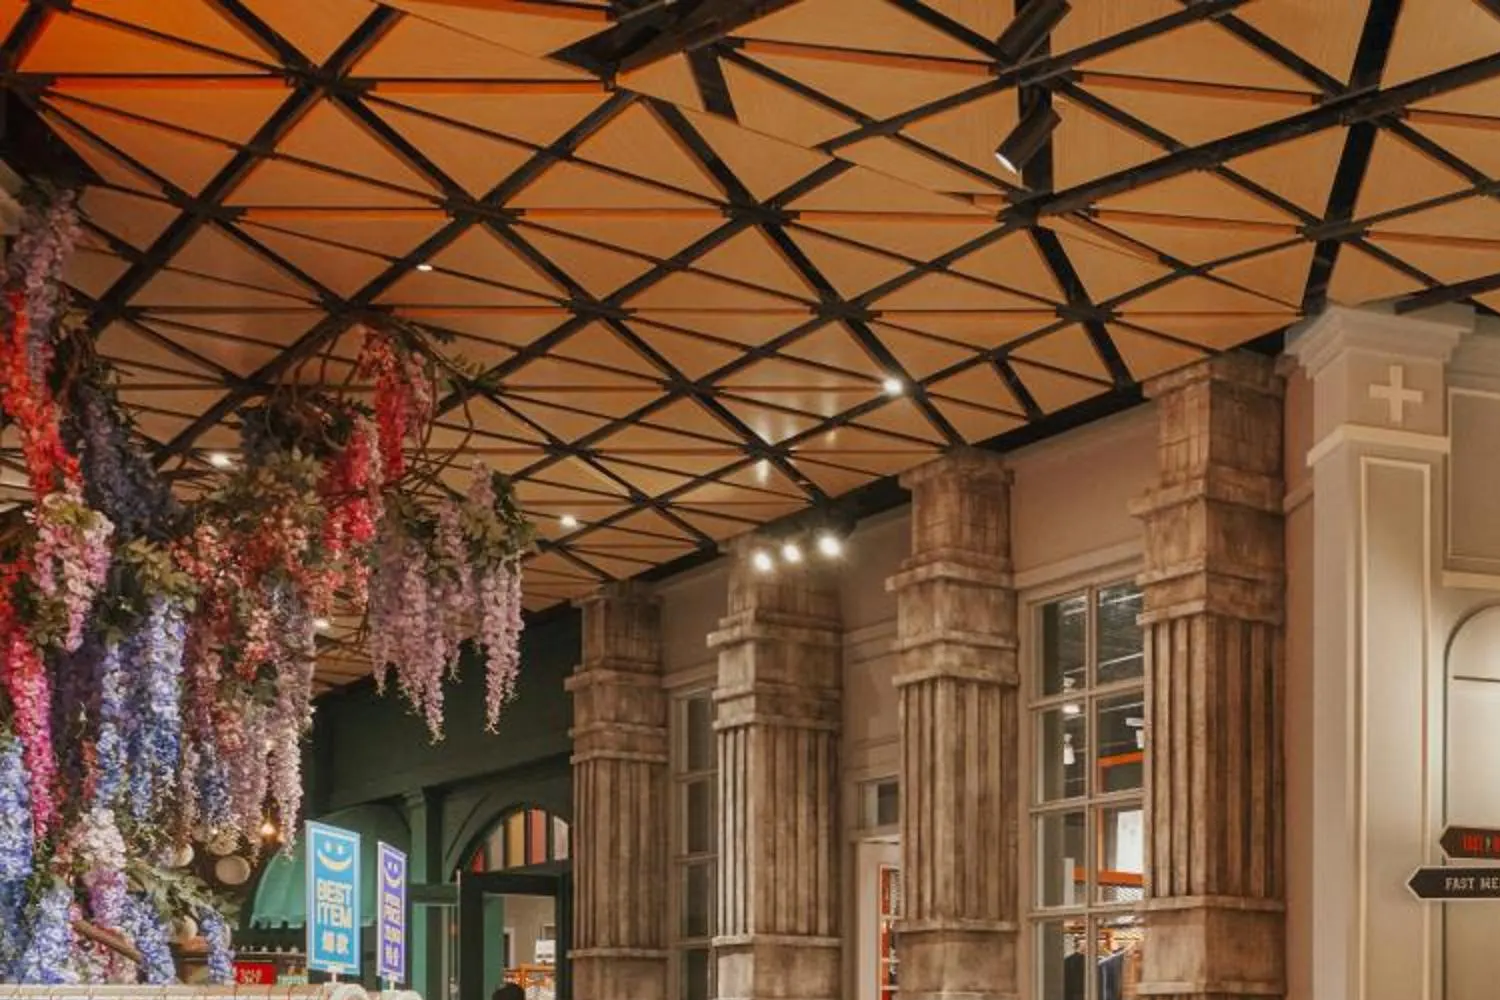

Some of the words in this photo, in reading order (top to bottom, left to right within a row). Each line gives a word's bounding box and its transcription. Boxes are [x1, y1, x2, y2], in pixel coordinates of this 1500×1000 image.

[316, 877, 353, 906] BEST
[1445, 876, 1475, 891] FAST
[317, 901, 353, 929] ITEM
